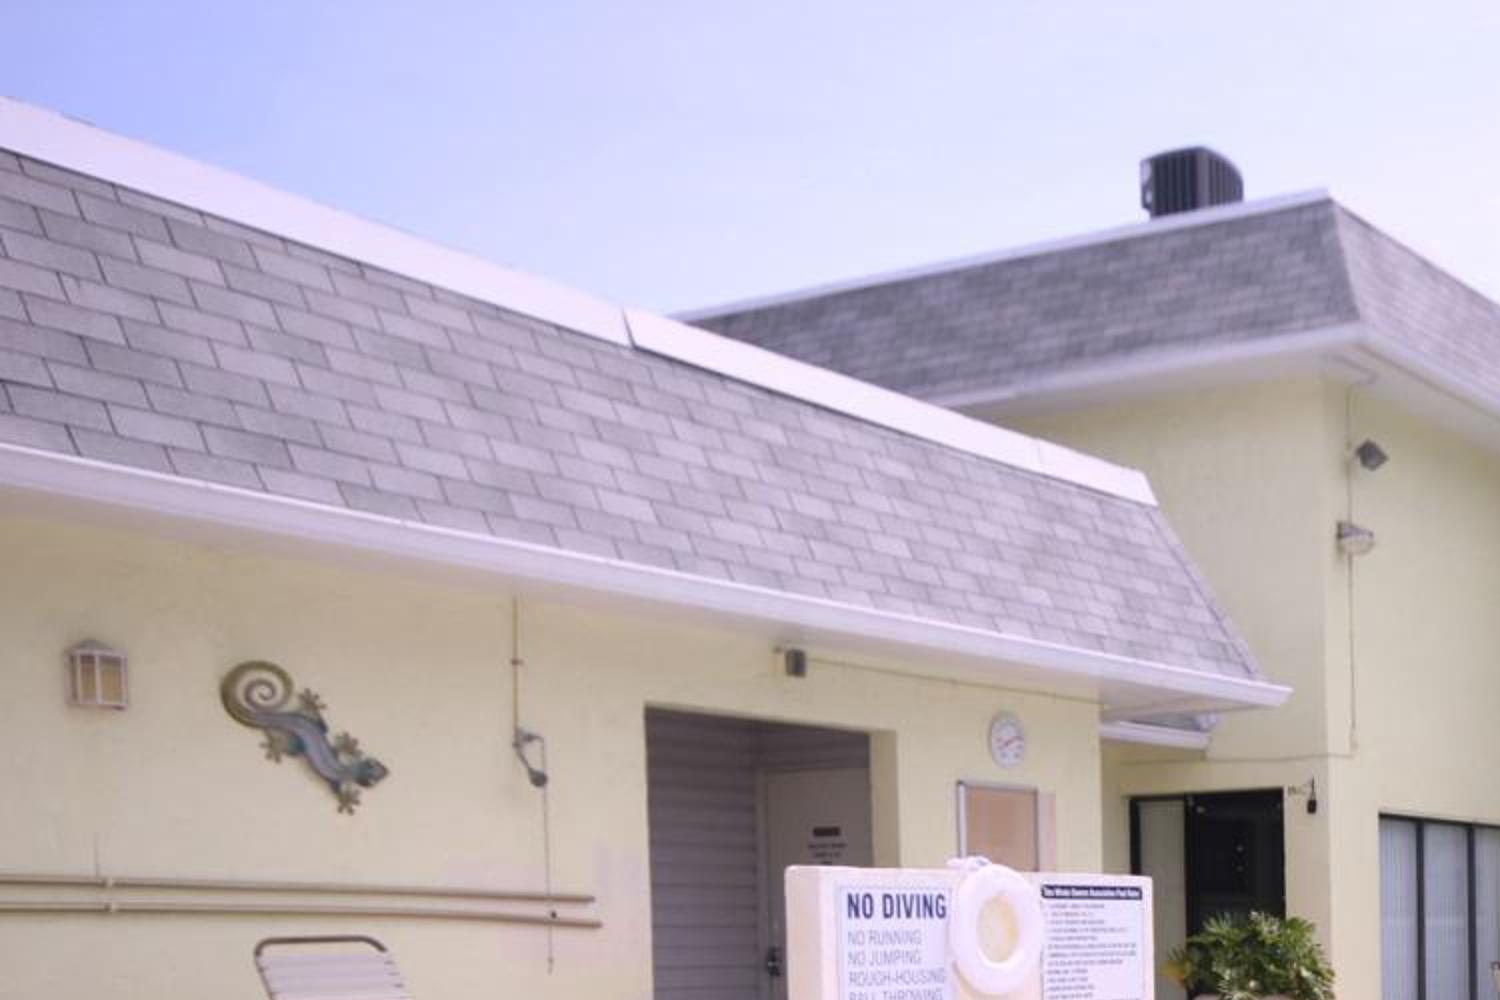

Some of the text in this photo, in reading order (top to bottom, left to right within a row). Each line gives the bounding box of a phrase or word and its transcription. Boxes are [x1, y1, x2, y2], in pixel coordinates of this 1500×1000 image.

[847, 892, 947, 919] NO DIVING
[848, 929, 922, 945] NO RUNNING
[848, 949, 922, 966] NO JUMPING
[849, 967, 946, 987] ROUGH-HOUSING
